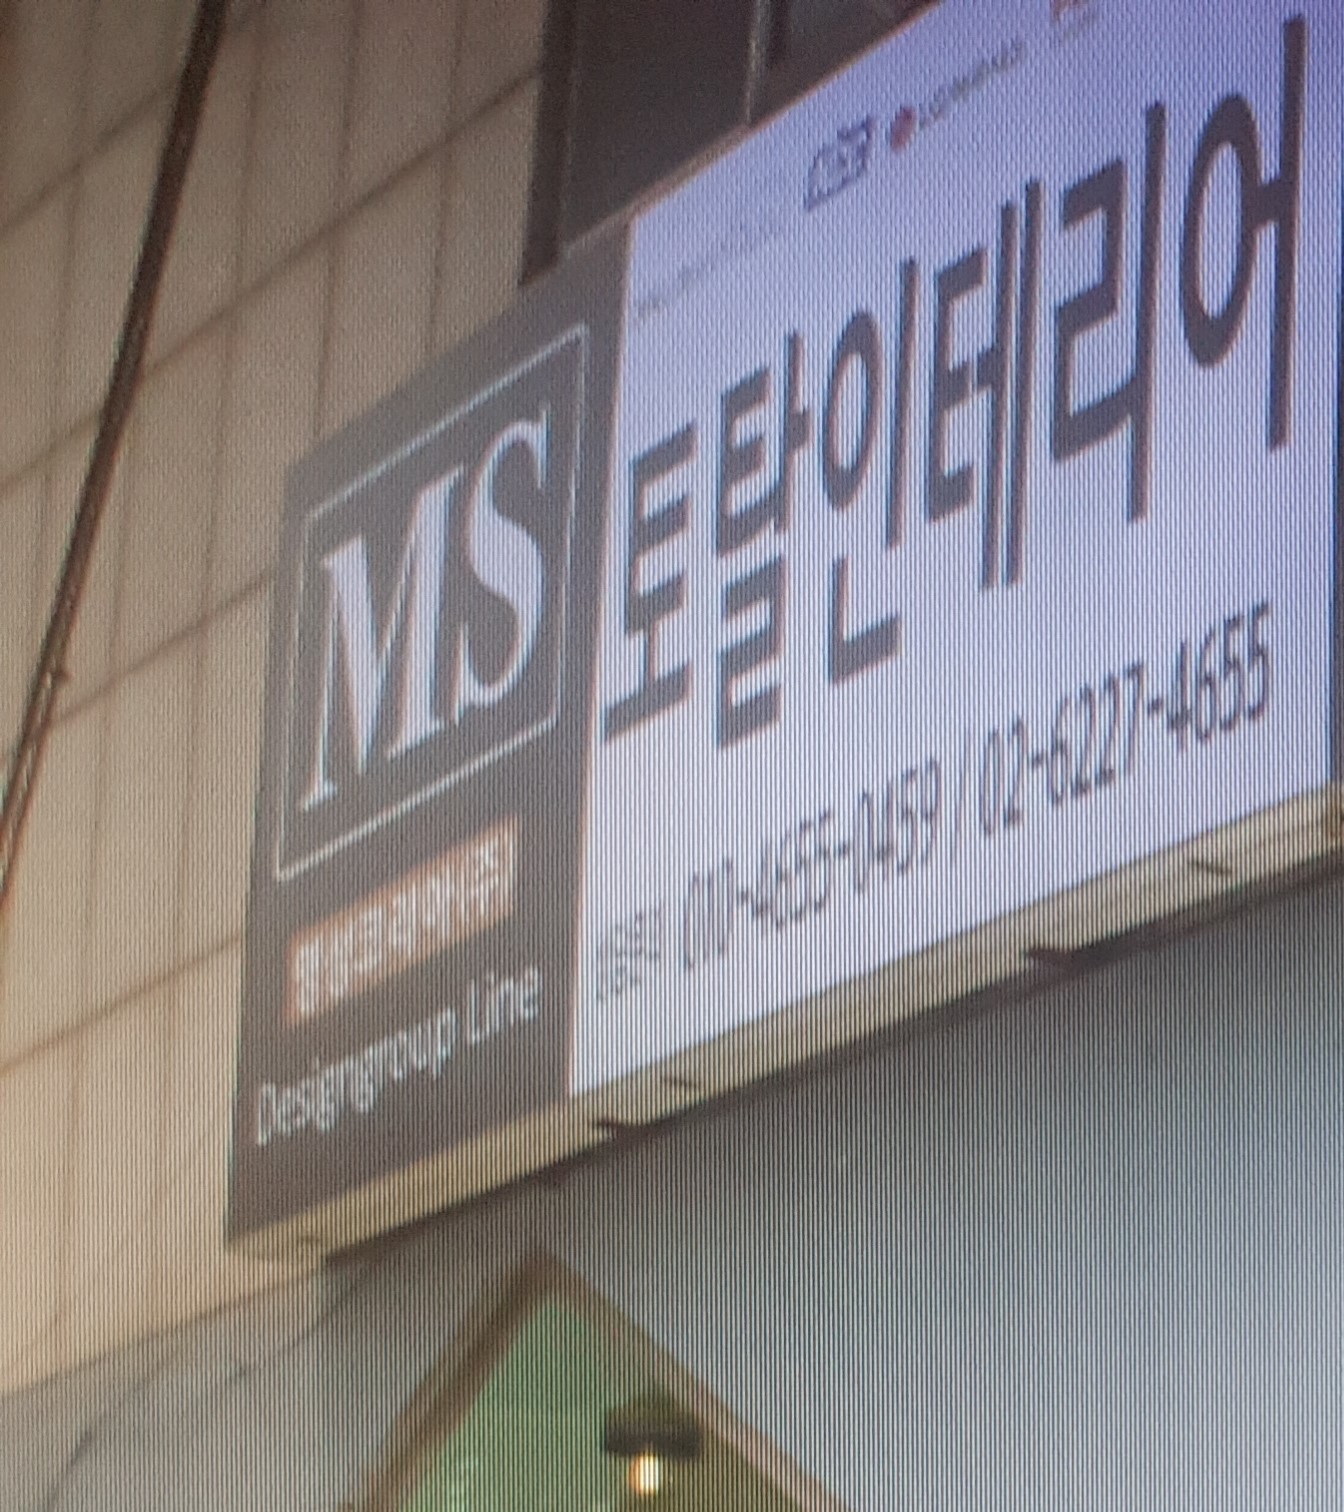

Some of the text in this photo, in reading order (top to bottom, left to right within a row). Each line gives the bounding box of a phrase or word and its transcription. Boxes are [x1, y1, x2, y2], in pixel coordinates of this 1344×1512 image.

[603, 14, 1308, 749] 토탈인테리어
[300, 410, 554, 812] MS
[679, 783, 941, 977] 010-4655-0459
[976, 605, 1274, 838] 02-6227-4655
[253, 967, 544, 1146] Designgroup Line
[290, 832, 518, 1016] 명성코리아(주)
